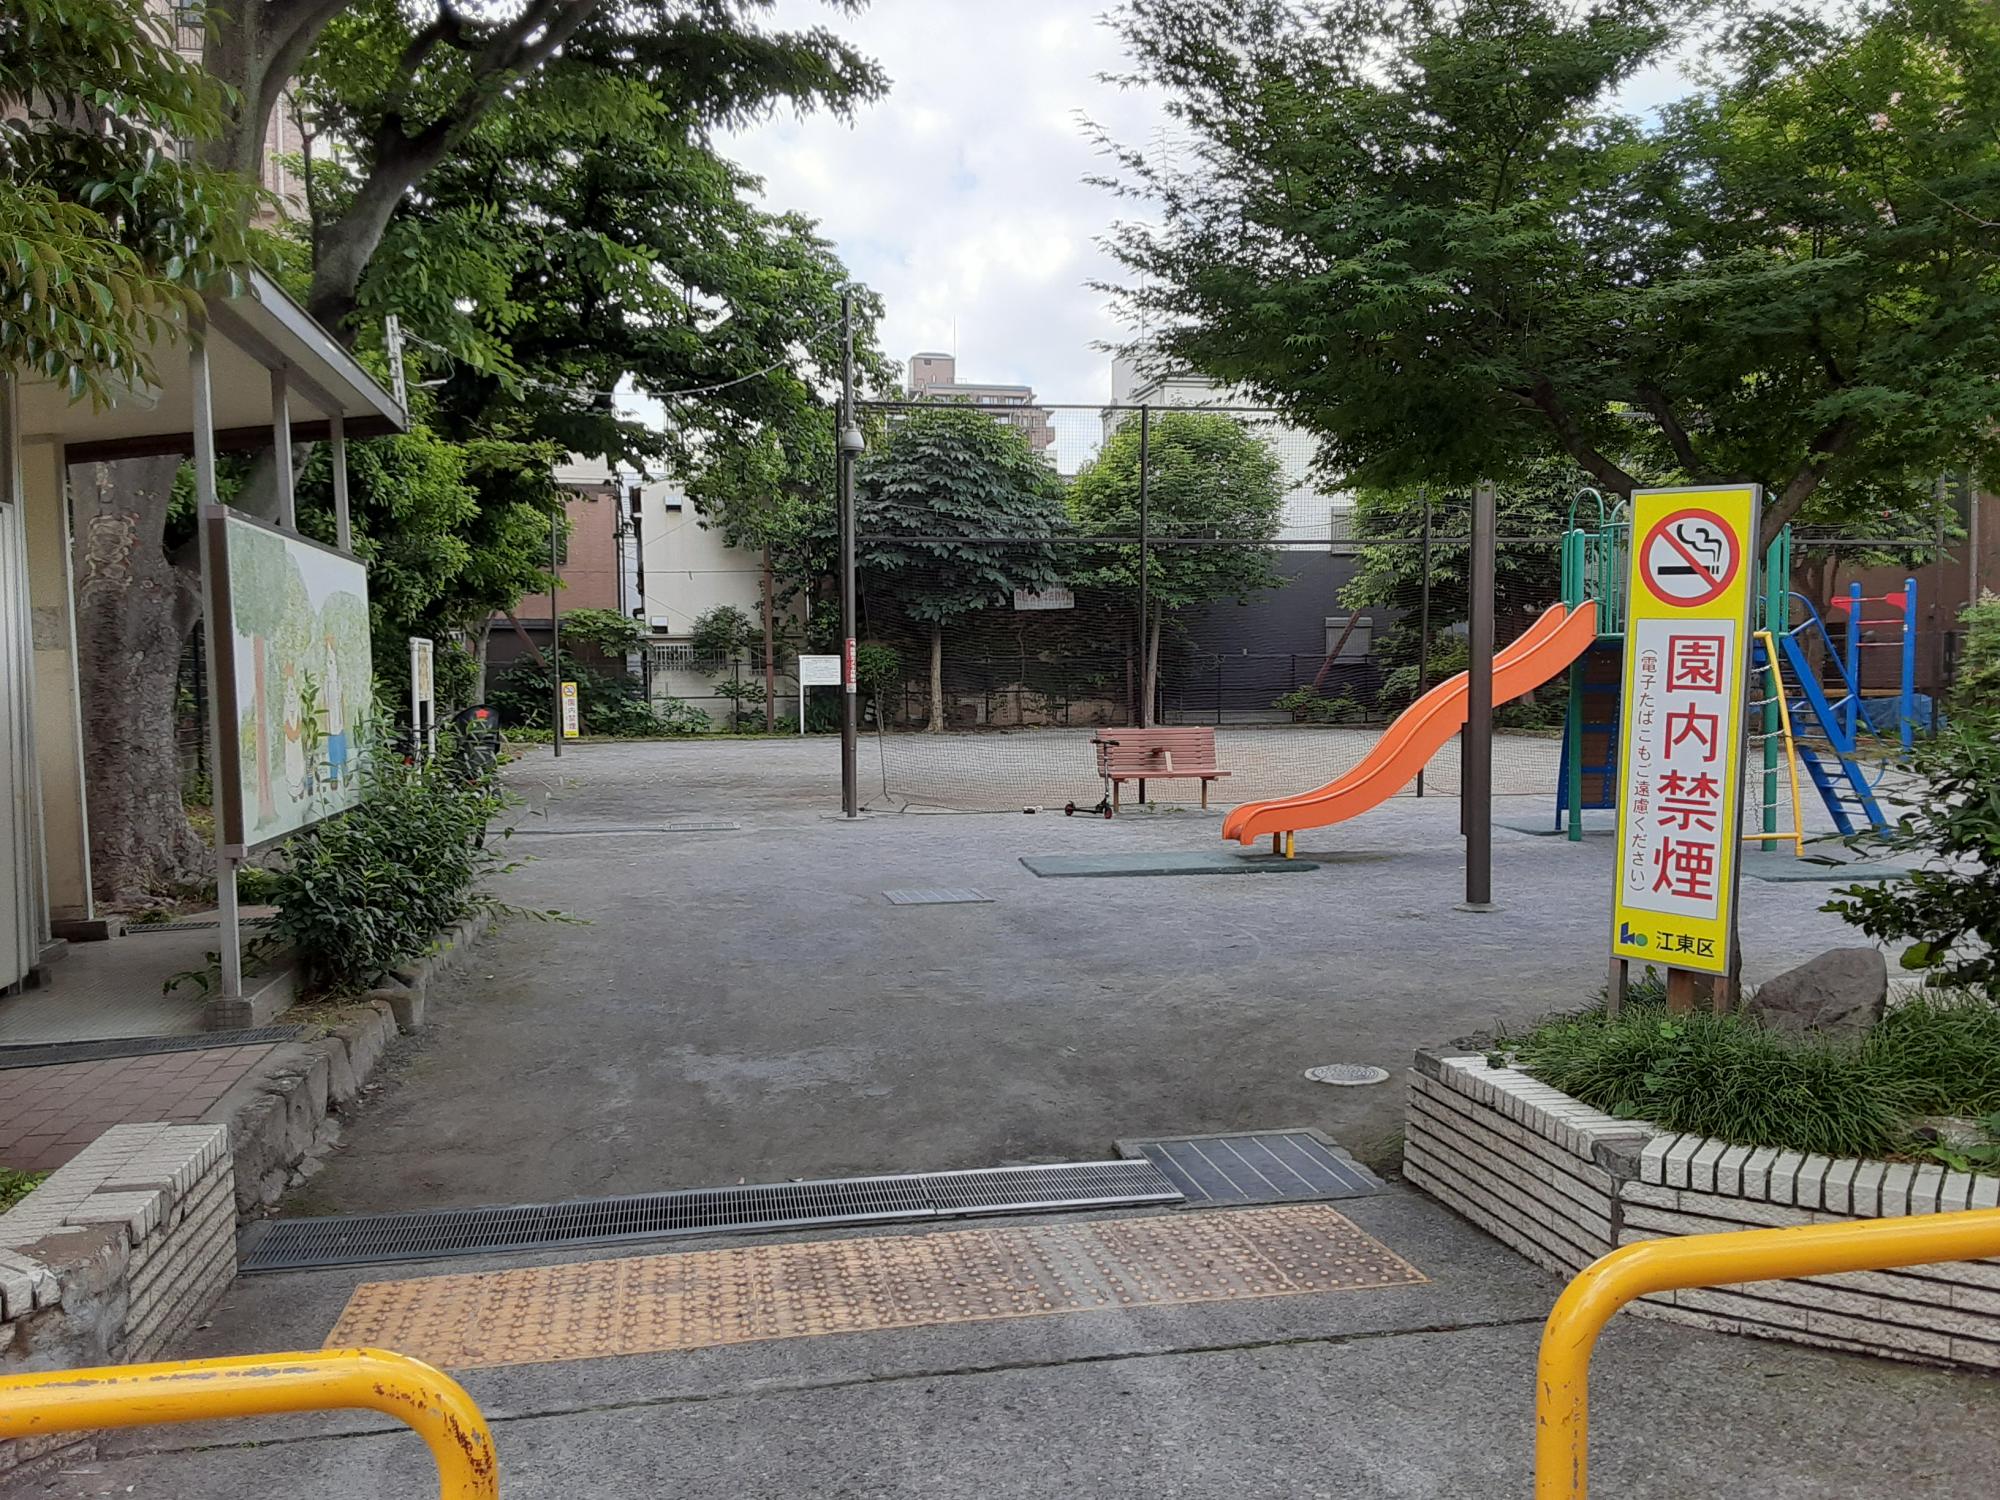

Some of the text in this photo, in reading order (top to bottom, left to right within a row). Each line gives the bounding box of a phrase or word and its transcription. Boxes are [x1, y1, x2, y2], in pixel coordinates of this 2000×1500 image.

[1652, 635, 1725, 901] 園内禁煙
[1656, 930, 1715, 958] 江東区
